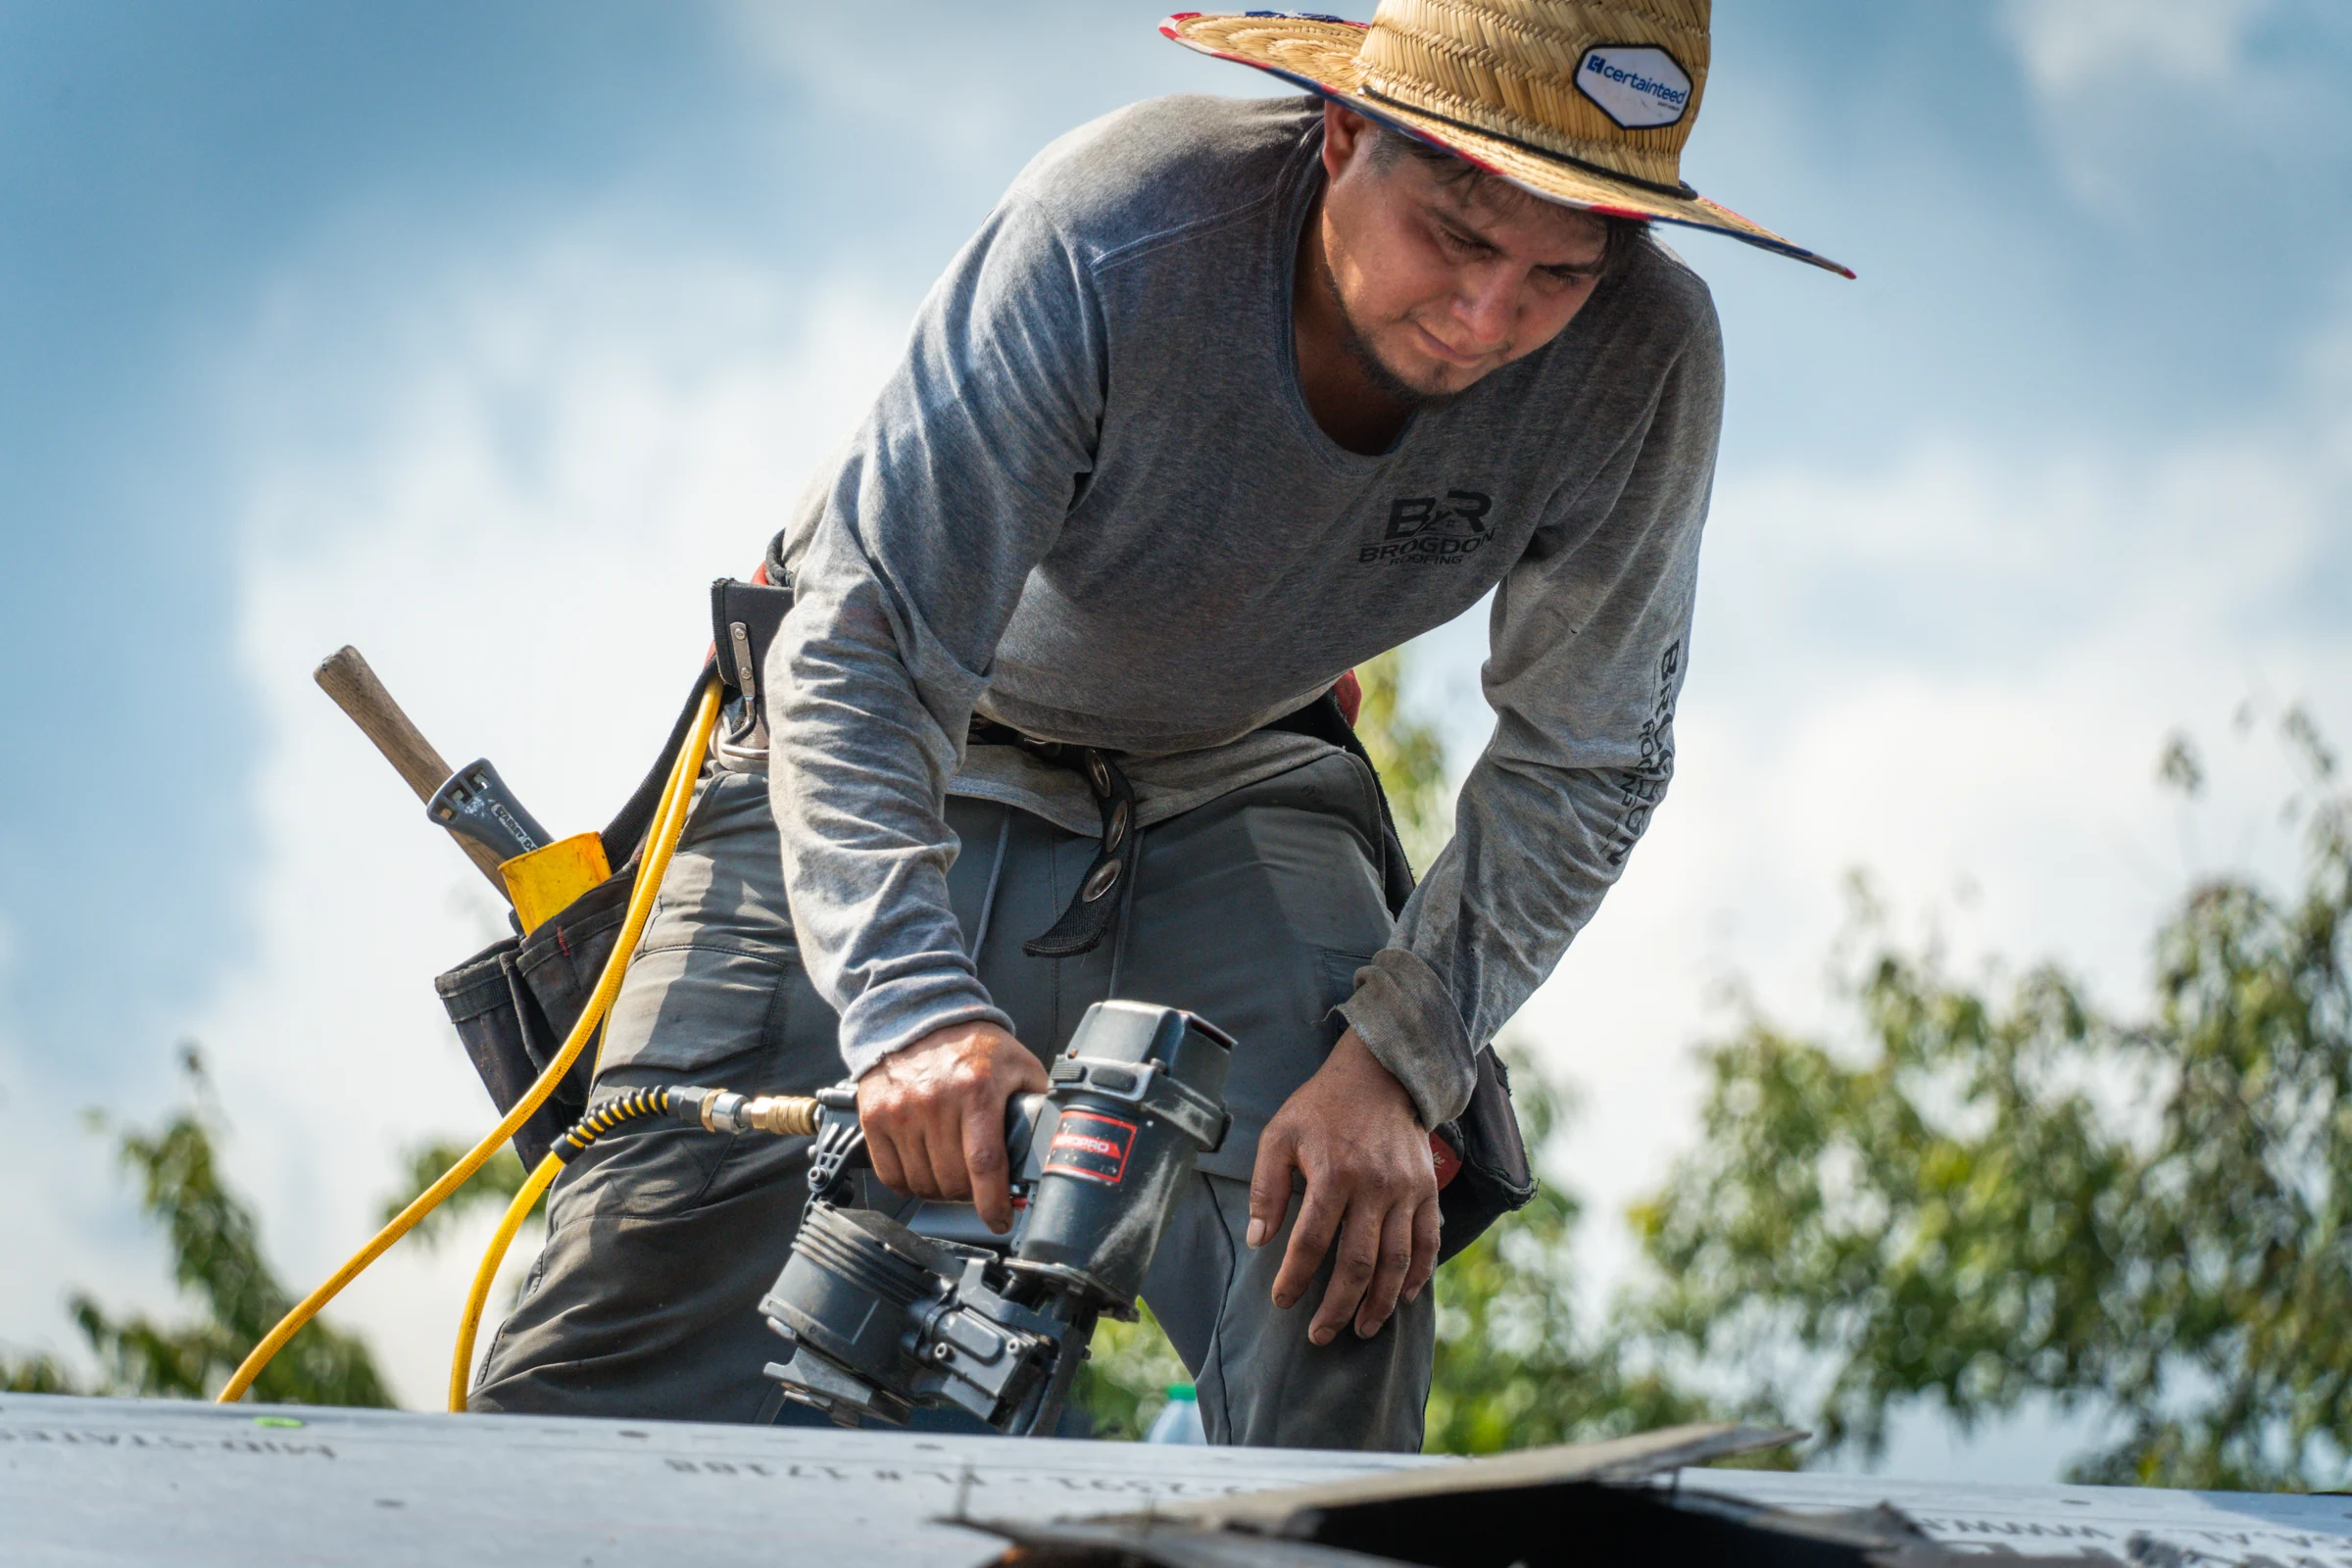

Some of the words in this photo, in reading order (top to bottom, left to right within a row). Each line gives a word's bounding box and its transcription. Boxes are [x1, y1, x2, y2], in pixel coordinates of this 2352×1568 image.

[1603, 66, 1688, 105] certainteed
[1358, 527, 1495, 563] BROGDON
[1390, 554, 1463, 565] ROOFING
